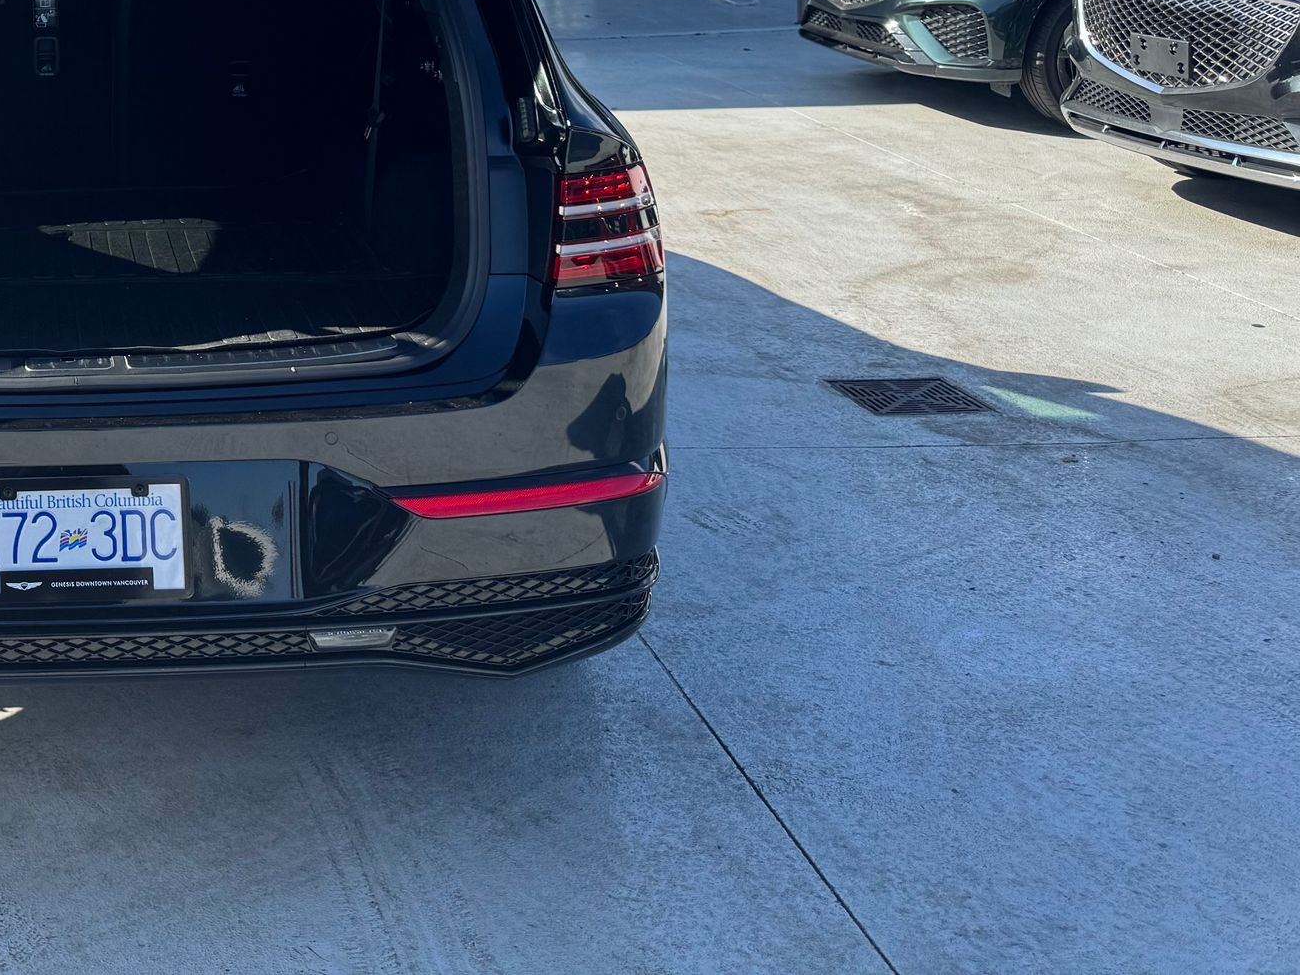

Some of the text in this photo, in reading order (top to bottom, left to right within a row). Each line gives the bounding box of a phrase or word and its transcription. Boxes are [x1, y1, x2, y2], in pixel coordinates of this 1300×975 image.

[47, 493, 91, 509] British
[94, 492, 163, 508] Columbia
[90, 509, 177, 562] 3DC
